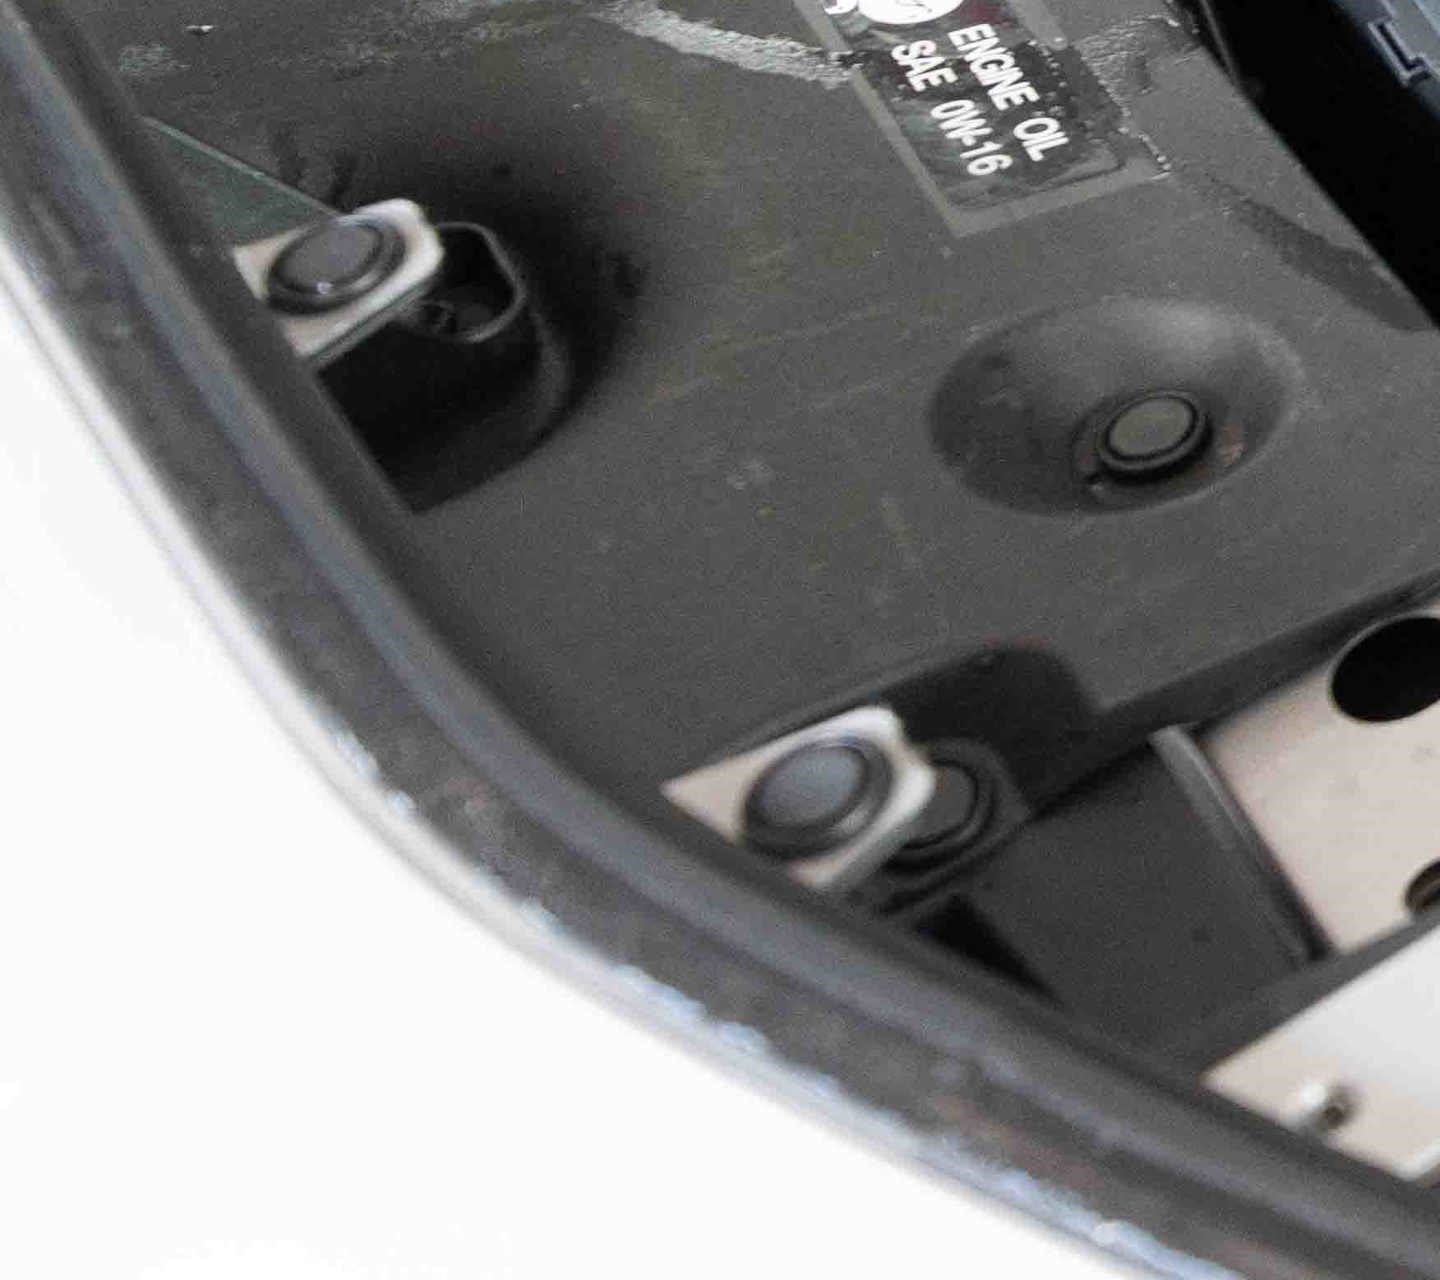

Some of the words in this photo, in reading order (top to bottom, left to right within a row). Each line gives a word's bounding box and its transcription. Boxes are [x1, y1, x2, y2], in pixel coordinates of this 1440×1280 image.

[891, 39, 959, 92] SAE
[930, 98, 1014, 177] 0W-16
[948, 22, 1040, 111] ENGINE
[1012, 116, 1070, 163] OIL
